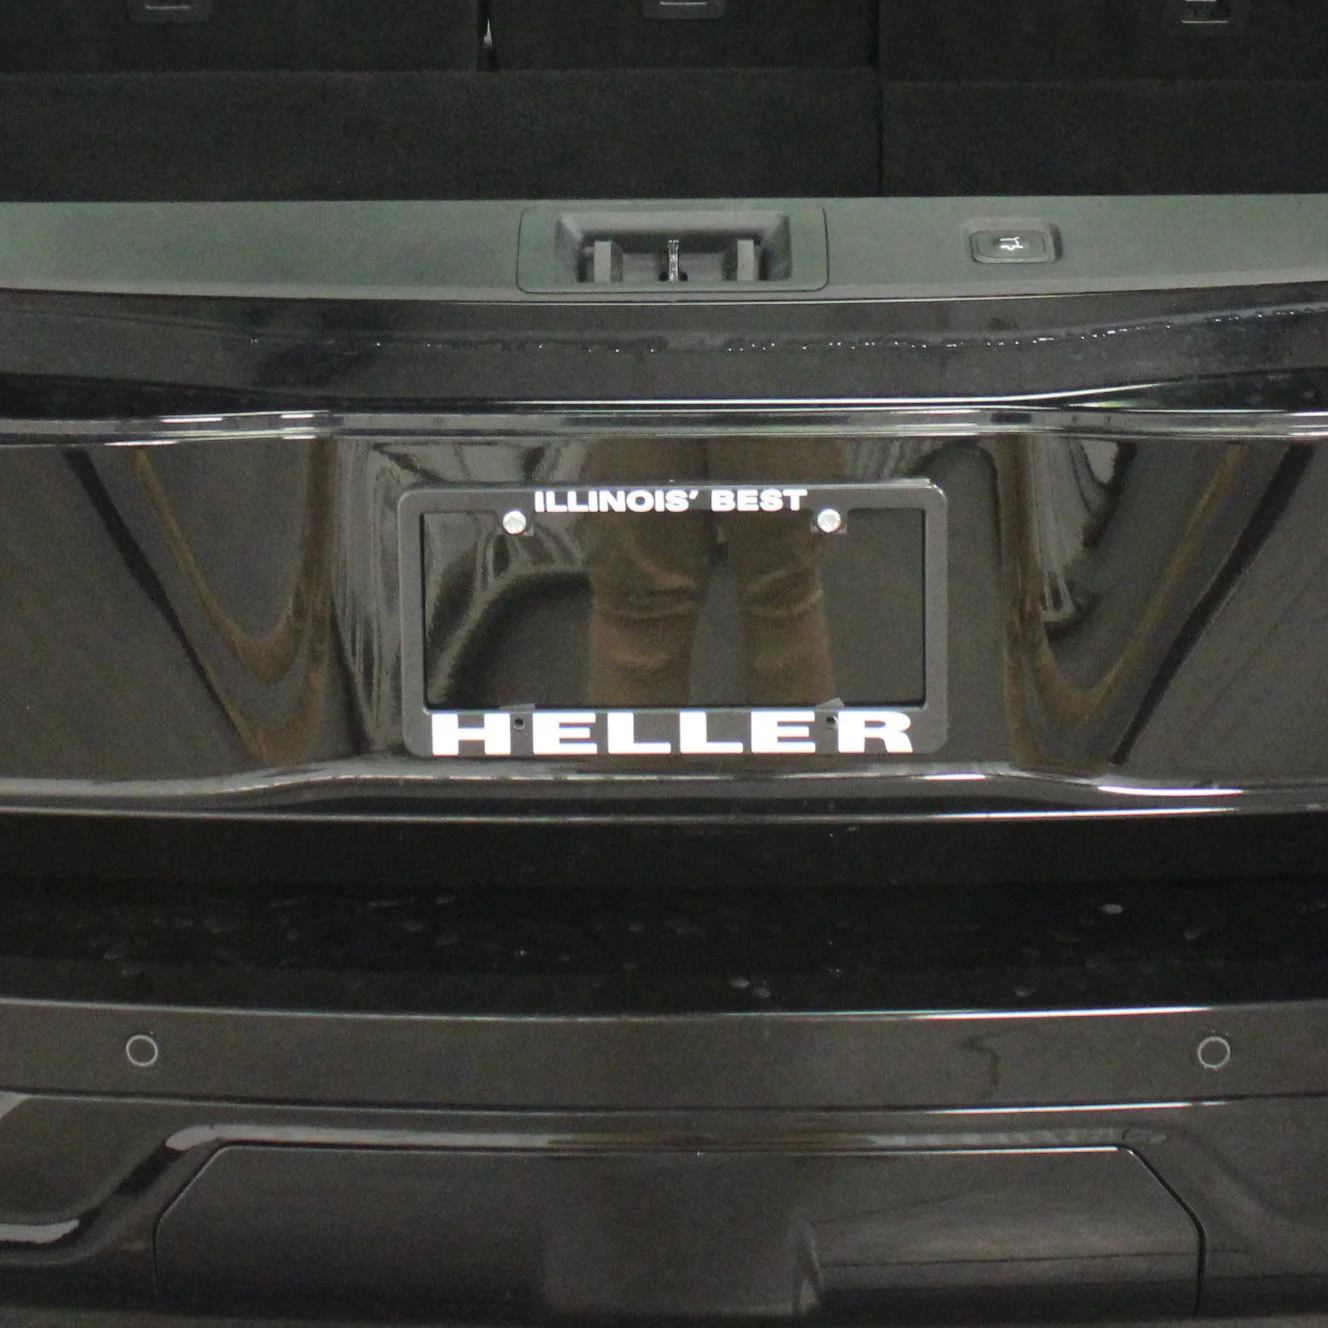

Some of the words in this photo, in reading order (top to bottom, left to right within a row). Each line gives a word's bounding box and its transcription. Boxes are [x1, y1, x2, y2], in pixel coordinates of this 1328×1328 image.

[534, 489, 698, 512] ILLINOIS'
[710, 488, 808, 512] BEST
[431, 711, 913, 755] HELLER
